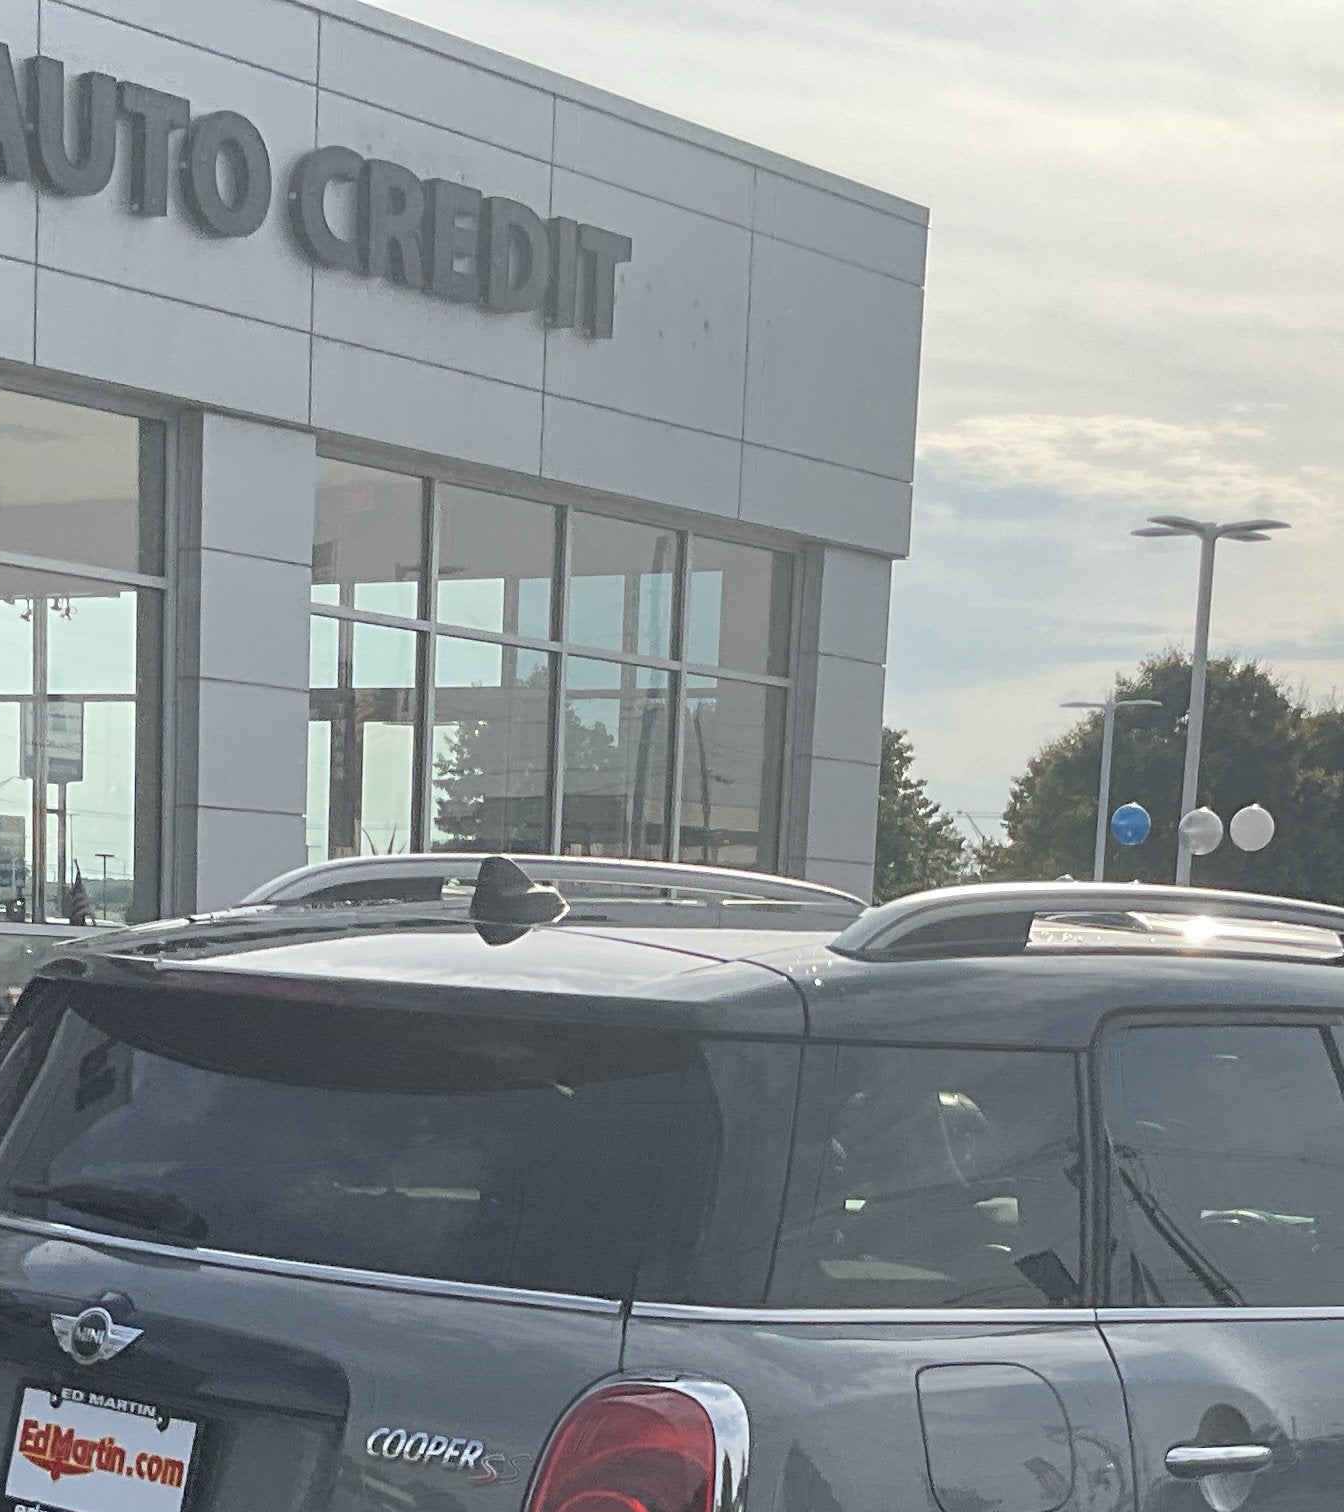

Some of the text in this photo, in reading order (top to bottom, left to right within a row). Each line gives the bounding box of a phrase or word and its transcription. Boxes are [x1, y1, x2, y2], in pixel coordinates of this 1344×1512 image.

[288, 145, 632, 339] CREDIT
[75, 1325, 105, 1345] MINI
[61, 1387, 155, 1418] ED MARTIN
[19, 1418, 184, 1489] EdMartin.com
[366, 1427, 484, 1469] COOPER
